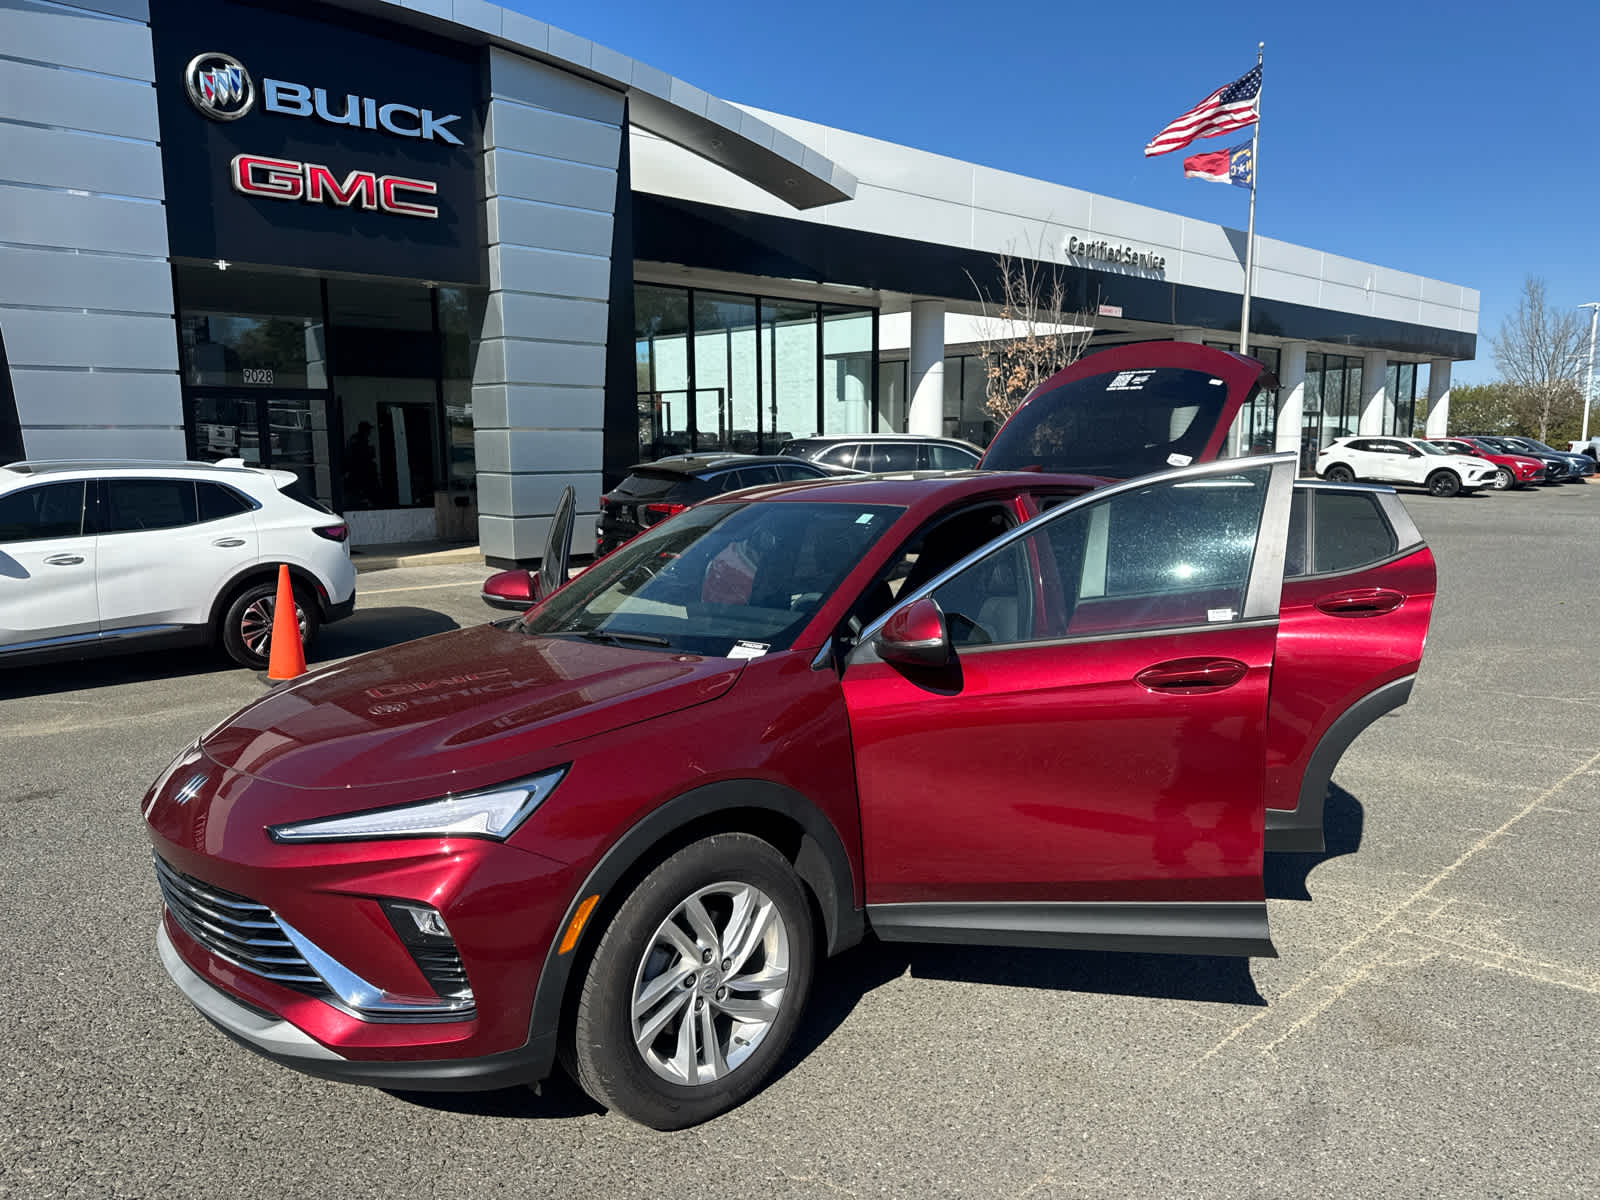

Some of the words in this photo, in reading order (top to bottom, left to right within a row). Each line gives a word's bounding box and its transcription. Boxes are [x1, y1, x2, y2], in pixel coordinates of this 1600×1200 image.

[263, 78, 464, 146] BUICK
[231, 153, 438, 218] GMC
[1068, 236, 1123, 263] Certified
[1124, 247, 1165, 270] Service
[243, 369, 273, 384] 9028
